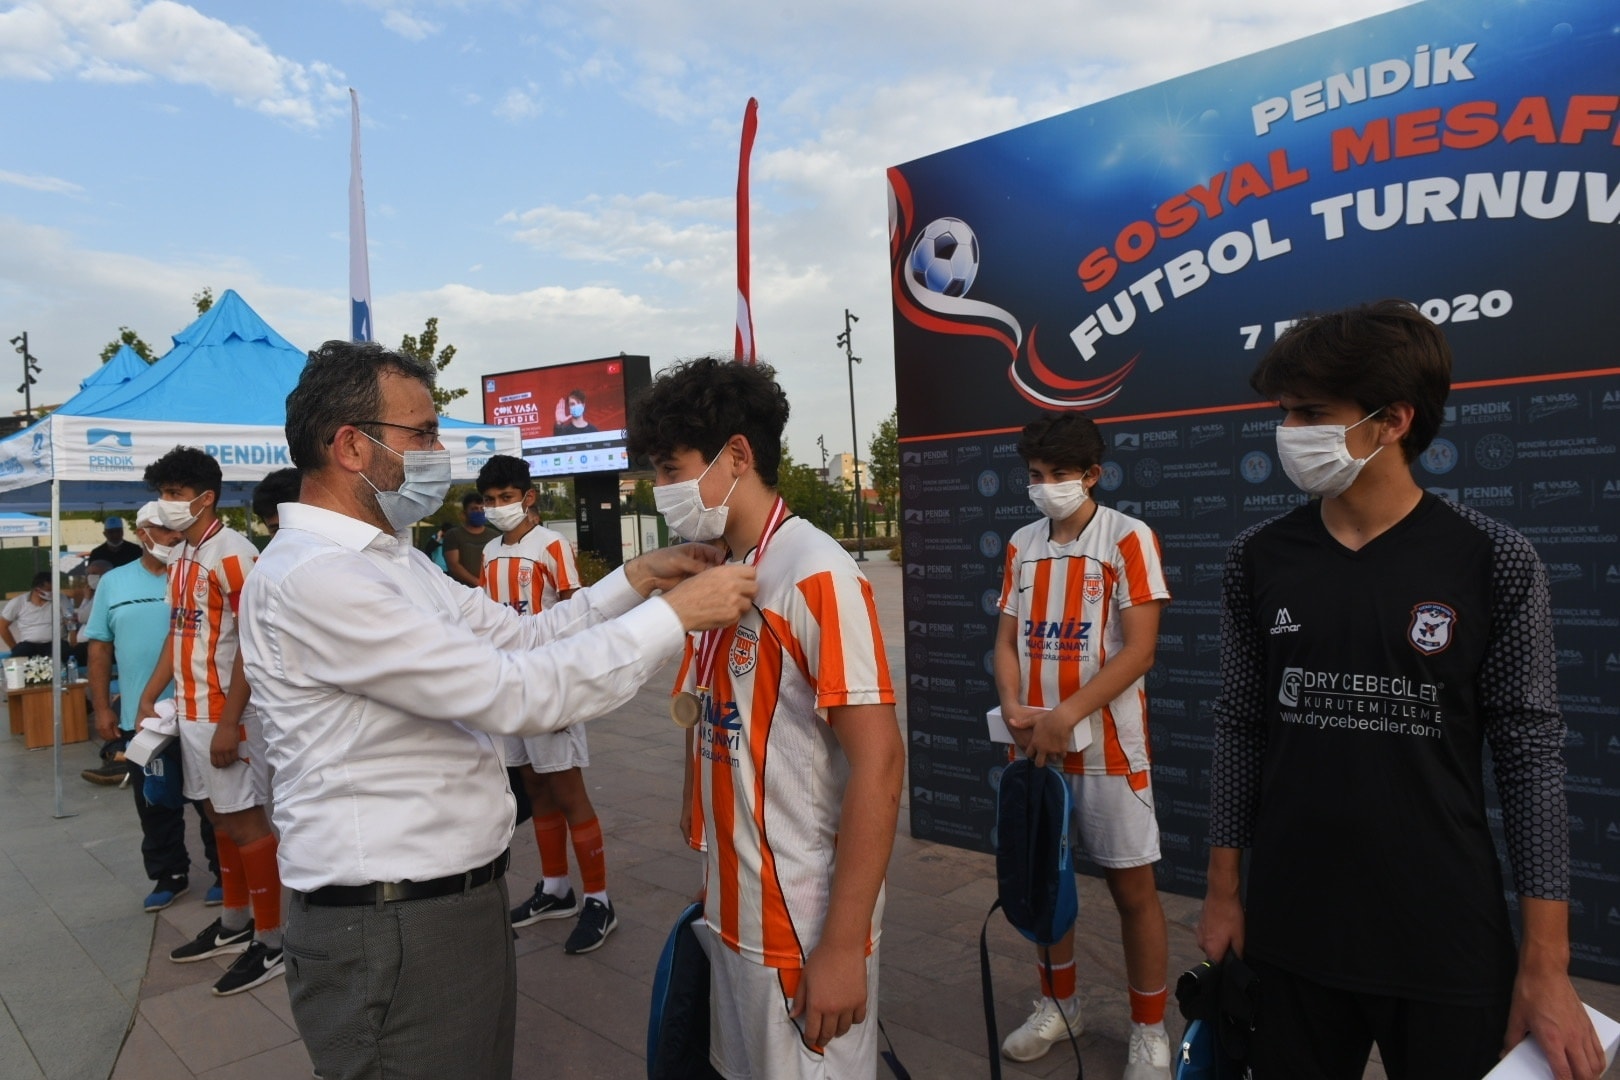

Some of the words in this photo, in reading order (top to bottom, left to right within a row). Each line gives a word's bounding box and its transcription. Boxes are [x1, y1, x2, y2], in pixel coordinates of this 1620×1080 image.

[1076, 148, 1309, 293] SOSYAL
[1330, 94, 1620, 173] MESAF
[1069, 218, 1292, 362] FUTBOL
[1310, 169, 1620, 241] TURNUV
[1239, 324, 1262, 350] 7
[1400, 289, 1513, 325] 020
[993, 443, 1017, 453] AHME
[1243, 494, 1285, 506] AHMET
